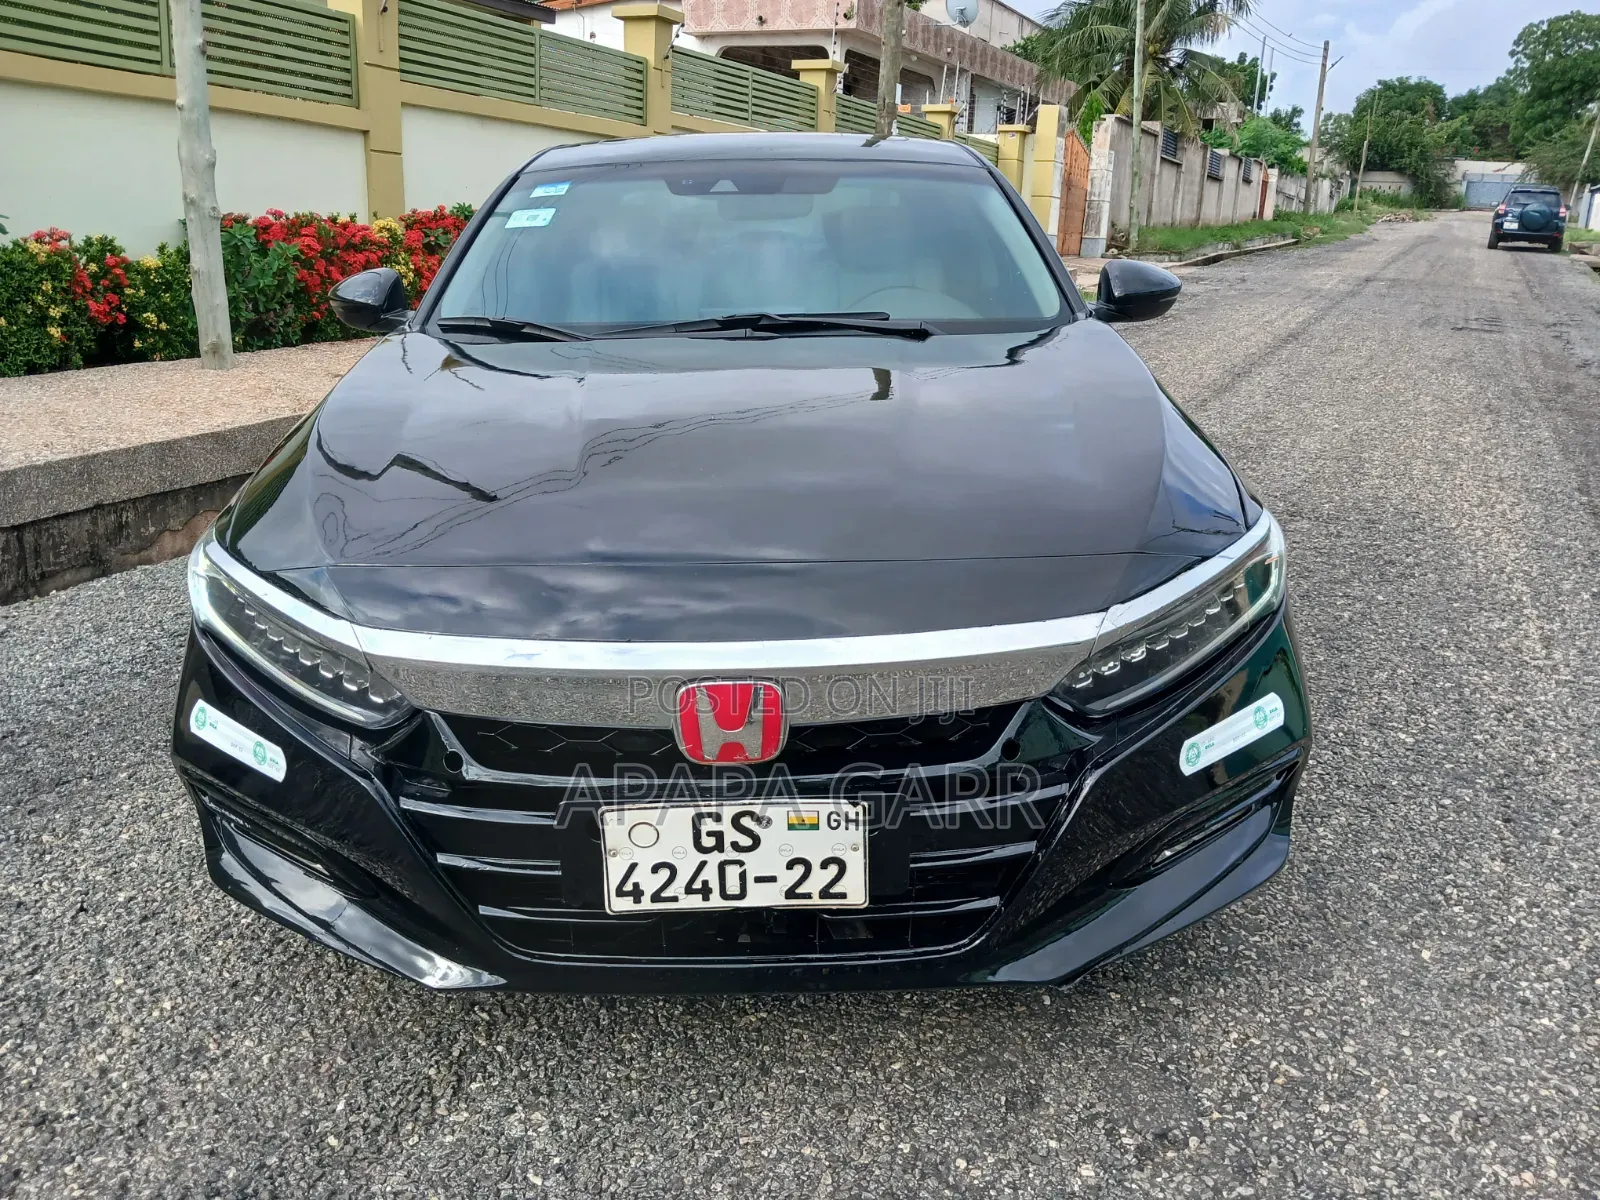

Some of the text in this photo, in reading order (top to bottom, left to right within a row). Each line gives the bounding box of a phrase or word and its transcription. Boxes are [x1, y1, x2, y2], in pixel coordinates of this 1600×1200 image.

[691, 809, 762, 854] GS
[826, 810, 860, 831] GH
[615, 856, 848, 904] 4240-22
